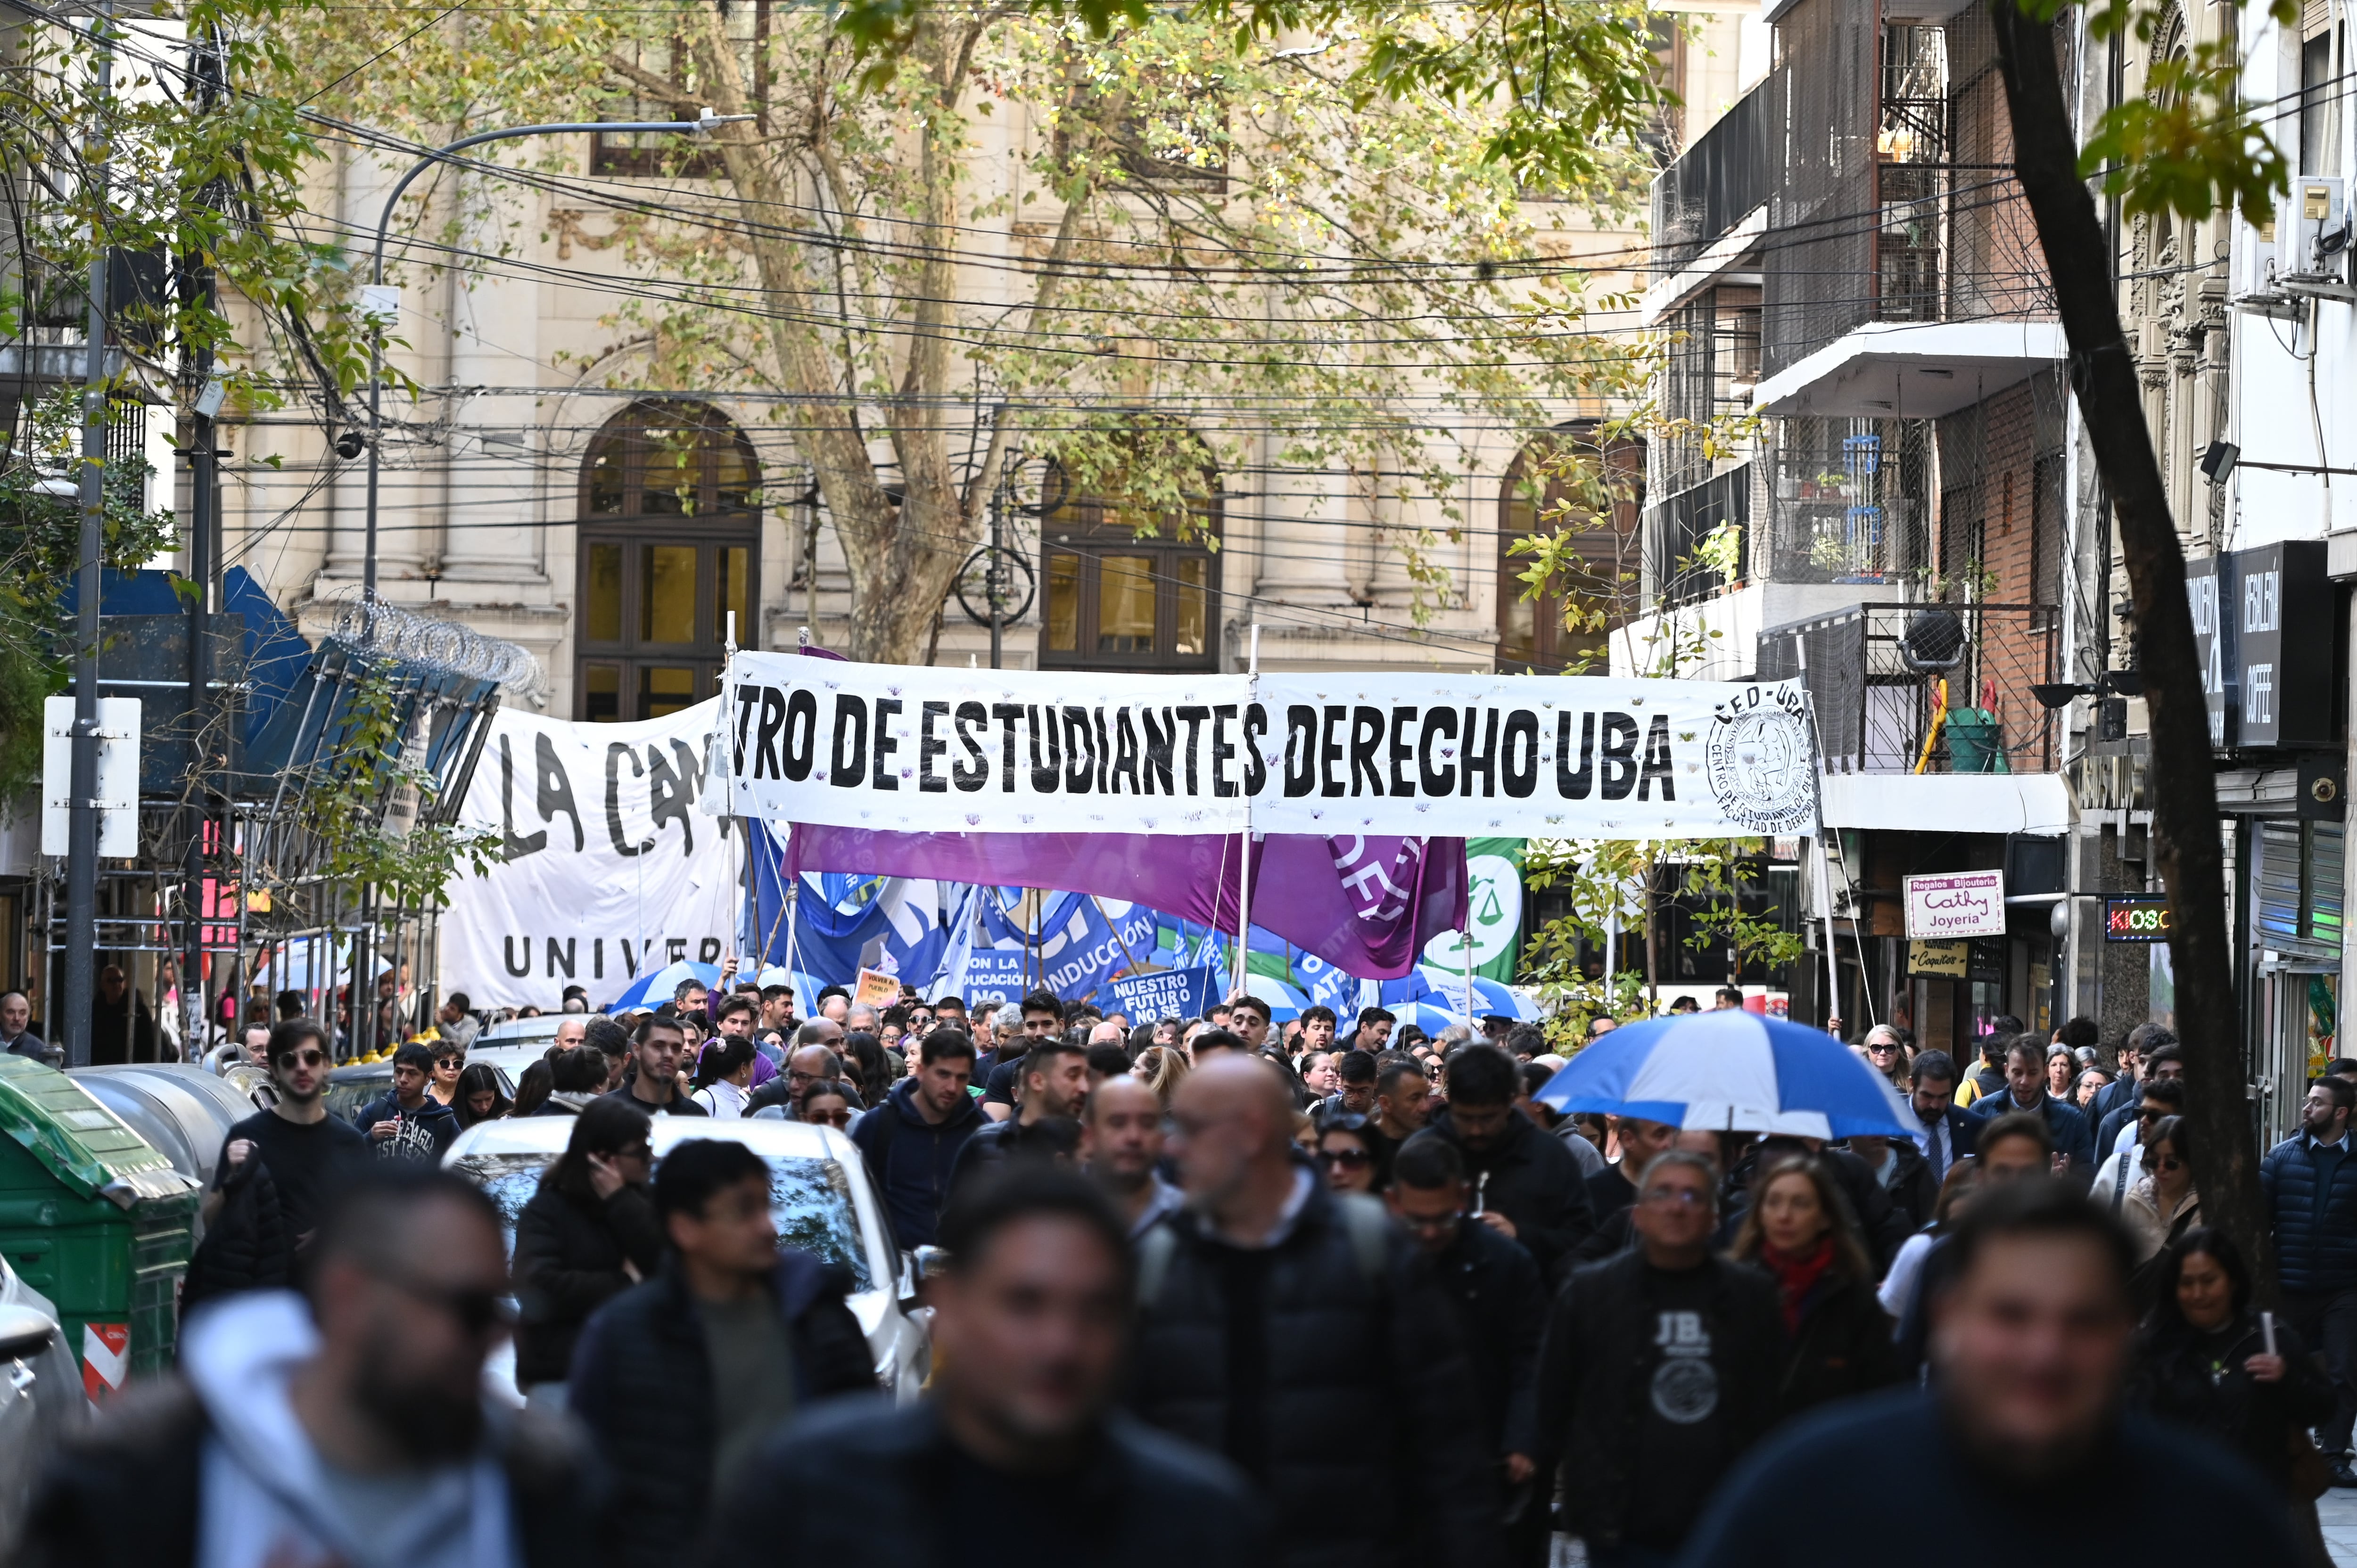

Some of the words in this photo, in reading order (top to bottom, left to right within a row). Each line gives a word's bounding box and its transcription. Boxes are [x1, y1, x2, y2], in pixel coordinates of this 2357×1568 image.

[2244, 557, 2278, 633] REGALERÍA
[2247, 664, 2272, 723] COFFEE
[733, 683, 817, 782] TRO
[830, 694, 902, 791] DE
[920, 701, 1267, 797] ESTUDIANTES
[1284, 705, 1539, 798] DERECHO
[1556, 710, 1675, 801] UBA
[1712, 744, 1728, 789] CENTRO
[1724, 790, 1739, 805] DE
[1737, 803, 1797, 821] ESTUDIANTES
[500, 731, 584, 860] LA
[1717, 796, 1767, 832] FACULTAD
[1771, 822, 1783, 833] DE
[1786, 798, 1814, 831] DERECHO
[1913, 881, 1947, 891] Regalos
[1954, 878, 1995, 888] Bijouterie
[1925, 890, 1988, 916] Cathy
[1930, 913, 1979, 928] Joyería
[2111, 909, 2170, 930] KIOSC
[969, 957, 991, 969] ON
[998, 958, 1018, 969] LA
[1030, 916, 1153, 993] ONDUCCIÓN
[868, 975, 887, 985] VOLVER
[868, 984, 888, 993] PUEBLO
[964, 971, 1031, 986] DUCACIÓN
[1113, 973, 1187, 999] NUESTRO
[971, 989, 1006, 1008] NO
[1135, 1008, 1157, 1024] NO
[1161, 1003, 1181, 1018] SE
